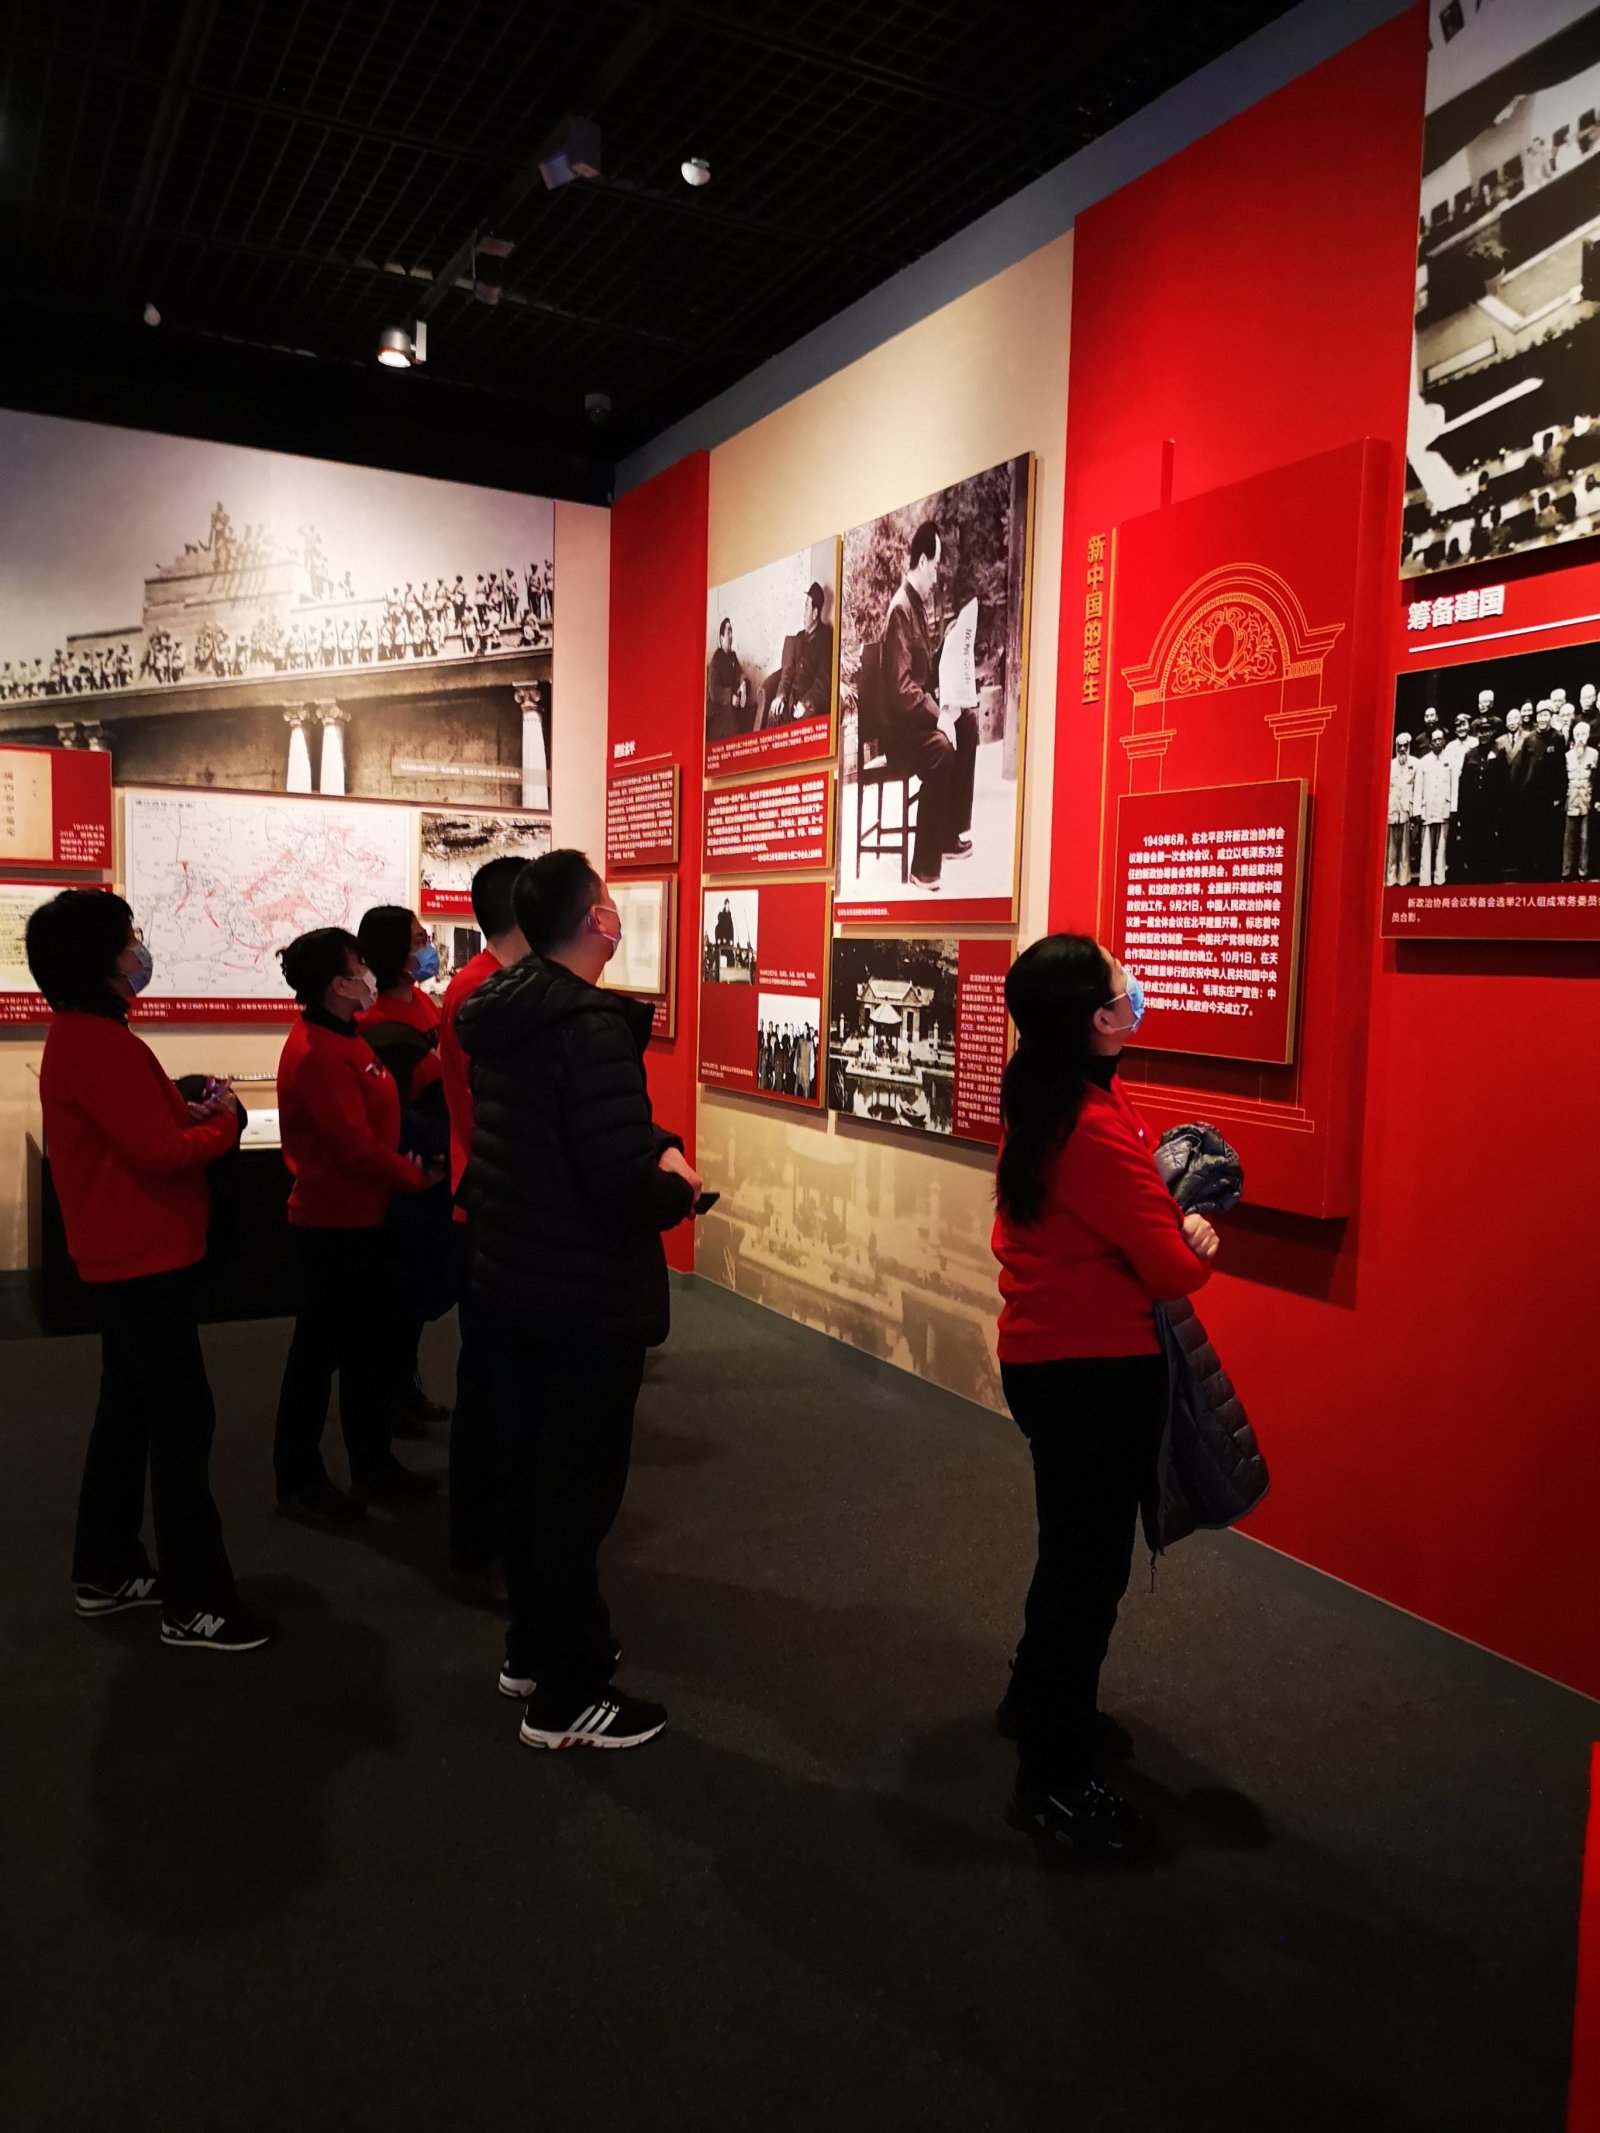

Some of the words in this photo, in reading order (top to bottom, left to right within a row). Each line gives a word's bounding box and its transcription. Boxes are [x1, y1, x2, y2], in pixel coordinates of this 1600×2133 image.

[1082, 533, 1106, 704] 新中国的诞生
[1408, 585, 1504, 630] 筹备建国
[125, 1578, 156, 1598] N
[193, 1614, 225, 1638] N
